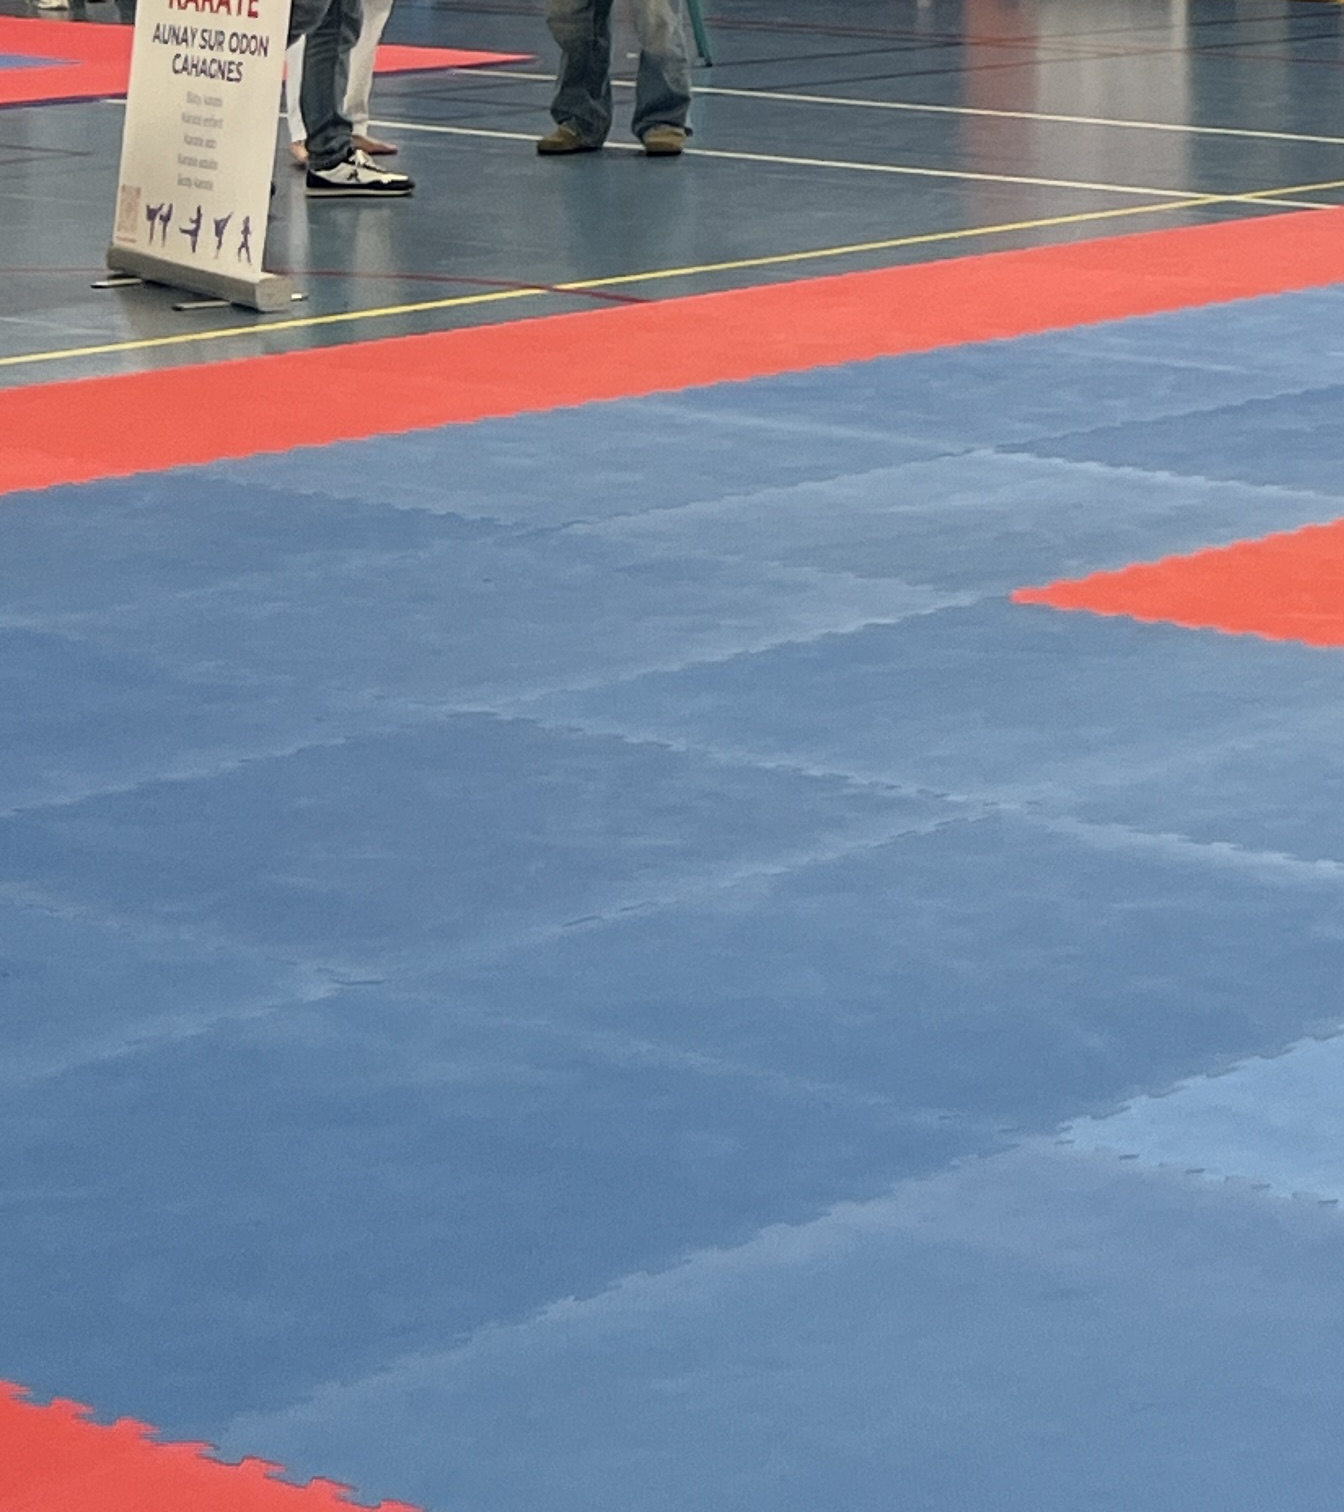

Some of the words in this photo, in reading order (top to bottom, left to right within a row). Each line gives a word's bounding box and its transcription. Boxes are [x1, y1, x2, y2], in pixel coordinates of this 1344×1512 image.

[152, 22, 198, 48] AUNAY
[198, 28, 226, 52] SUR
[228, 31, 269, 57] ODON
[172, 53, 243, 82] CAHAGNES
